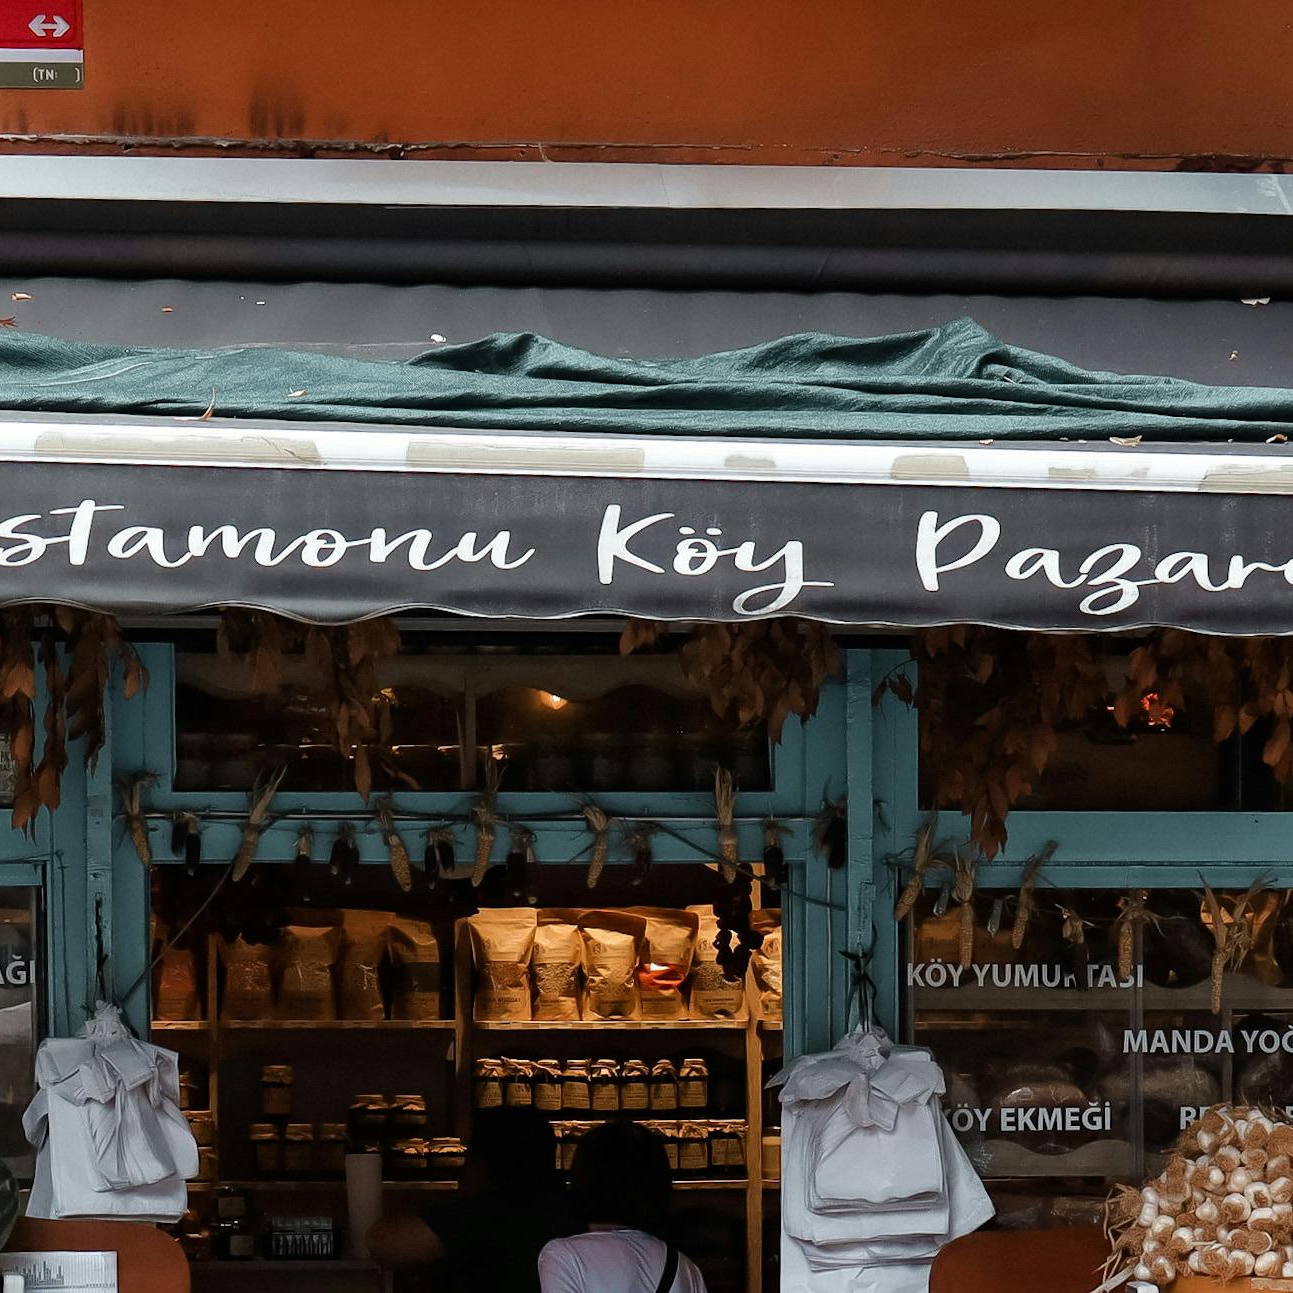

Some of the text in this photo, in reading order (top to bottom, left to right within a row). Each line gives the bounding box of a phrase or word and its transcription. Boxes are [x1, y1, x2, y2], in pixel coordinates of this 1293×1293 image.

[597, 504, 835, 615] Köy
[907, 958, 964, 988] KÖY
[1122, 1030, 1235, 1054] MANDA
[1001, 1101, 1112, 1132] EKMEĞİ
